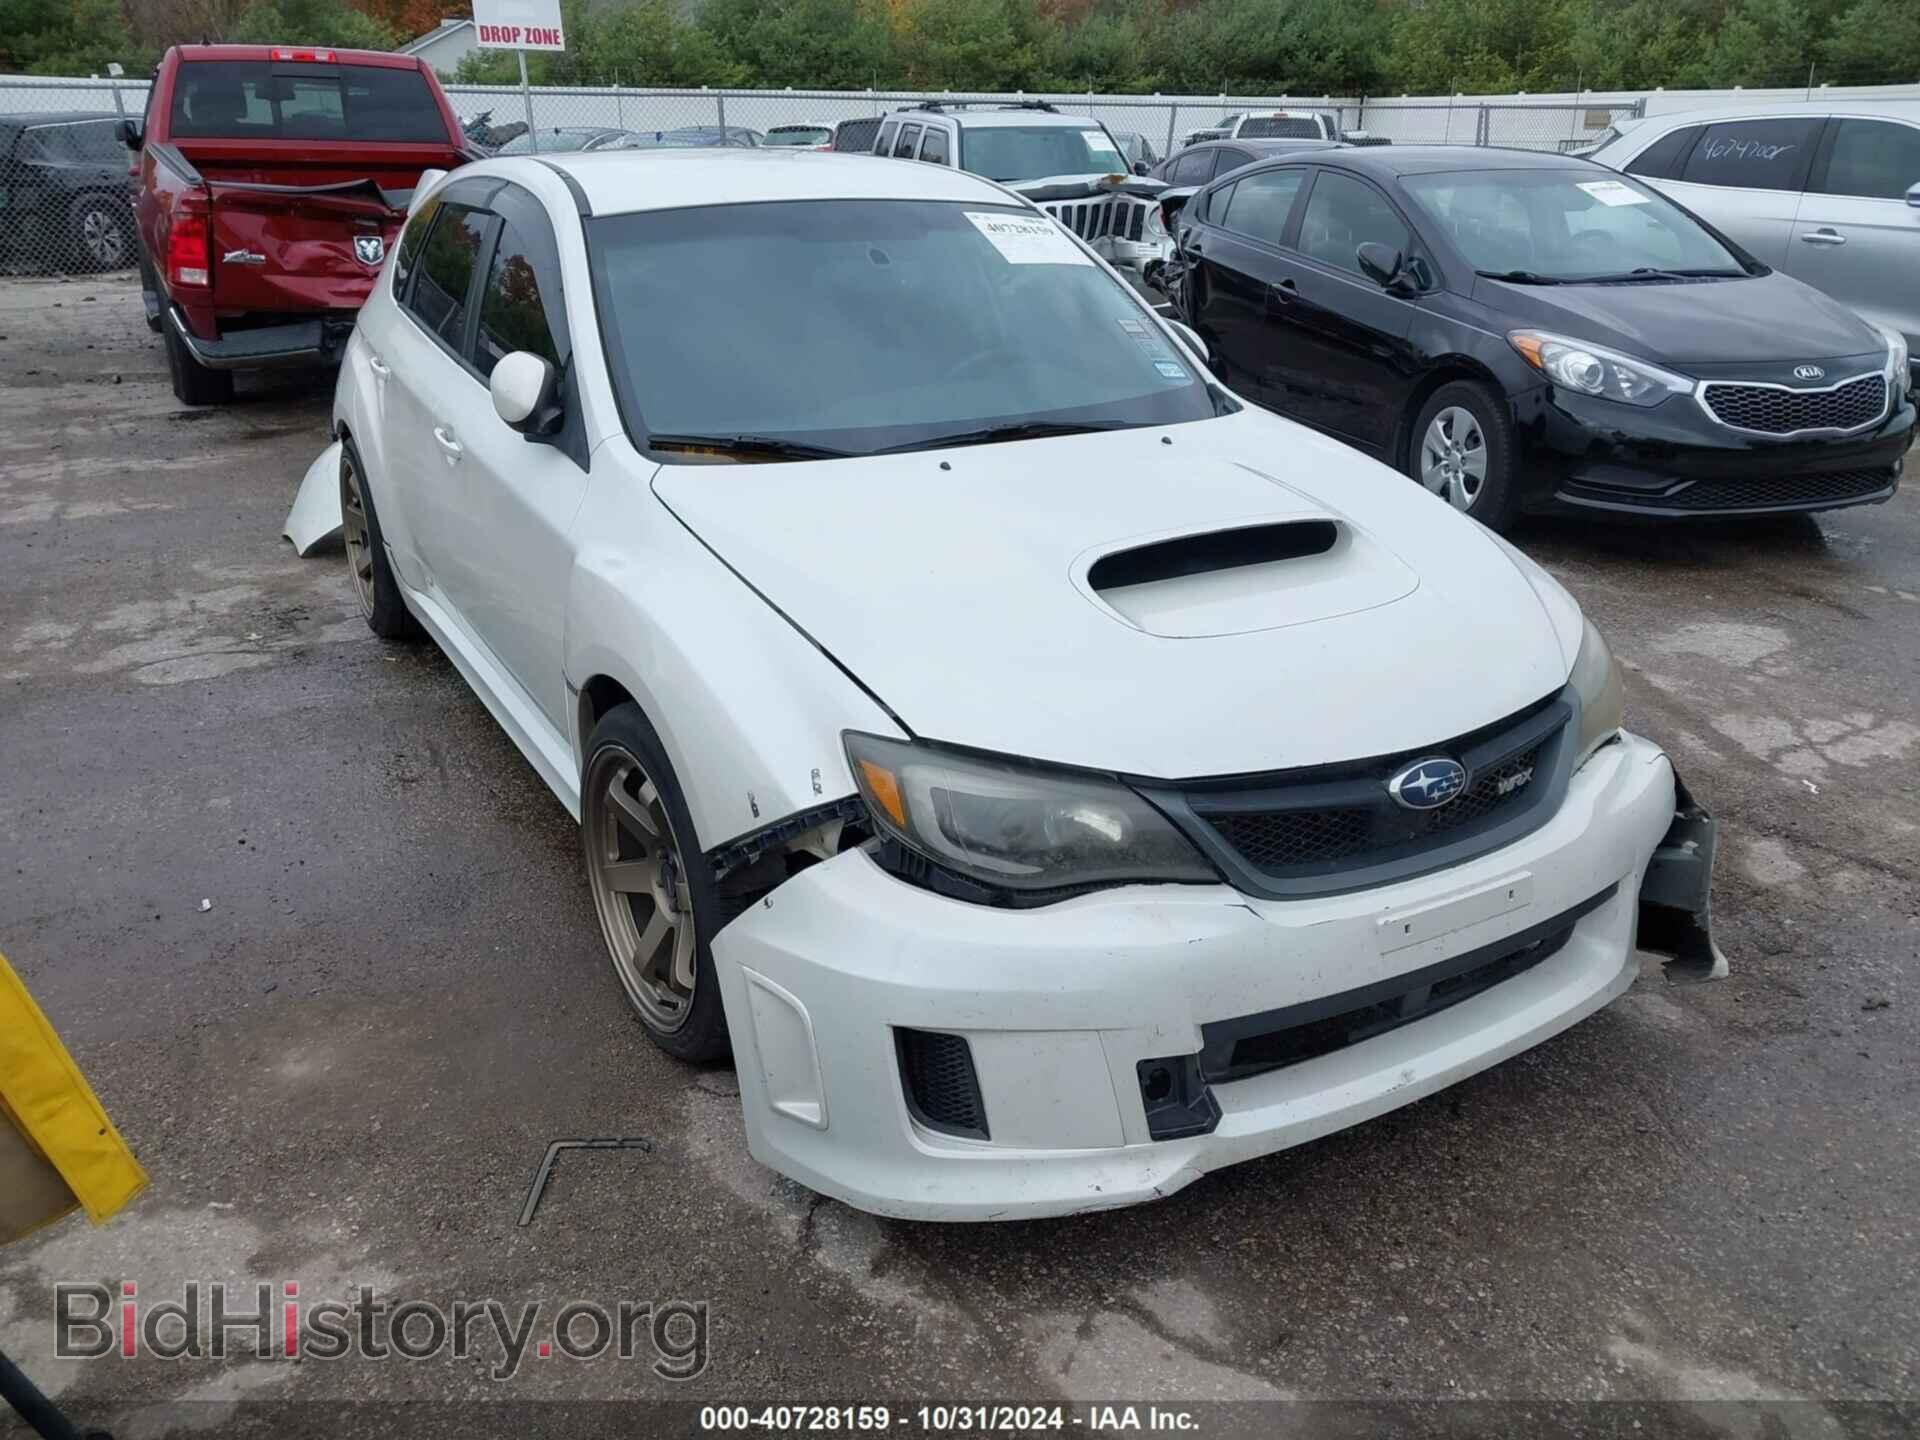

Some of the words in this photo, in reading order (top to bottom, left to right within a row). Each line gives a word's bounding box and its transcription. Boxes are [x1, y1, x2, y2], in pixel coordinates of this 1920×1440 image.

[480, 25, 520, 43] DROP
[524, 27, 561, 45] ZONE
[1498, 767, 1535, 795] WRX
